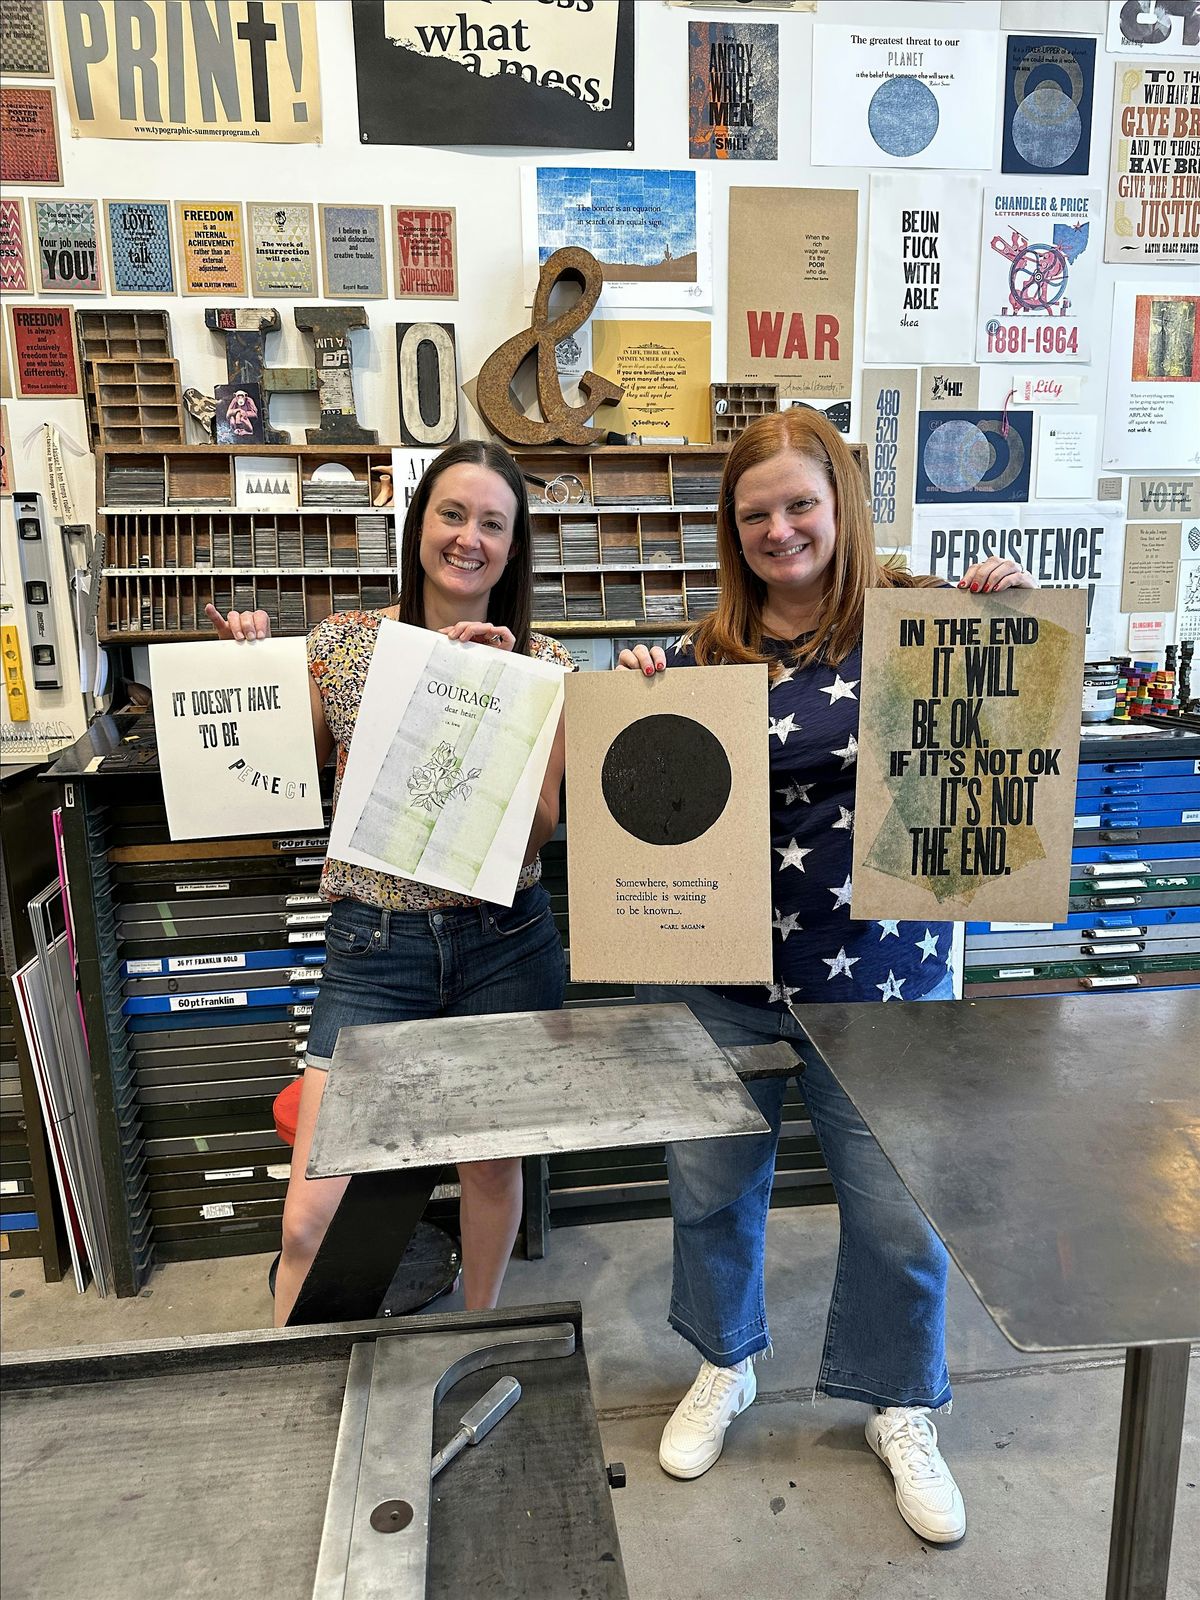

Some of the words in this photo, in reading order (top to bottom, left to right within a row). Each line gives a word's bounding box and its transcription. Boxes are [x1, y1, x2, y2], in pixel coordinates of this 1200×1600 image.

[415, 13, 531, 53] what
[851, 34, 867, 44] The
[869, 36, 903, 46] greatest
[906, 36, 931, 46] threat
[934, 38, 942, 46] to
[709, 42, 754, 73] ANGRY
[888, 51, 924, 66] PLANET
[462, 53, 481, 75] a
[499, 57, 610, 107] mess.
[710, 72, 753, 103] WHITE
[1144, 84, 1165, 104] WHO
[1166, 84, 1189, 104] HAVE
[8, 109, 38, 117] POSTER
[709, 102, 754, 127] MEN
[1121, 106, 1170, 137] GIVE
[134, 125, 261, 138] www.typographic-summerprogram.ch
[1130, 139, 1150, 156] AND
[1153, 140, 1167, 156] TO
[1129, 157, 1171, 174] HAVE
[1118, 175, 1145, 198] GIVE
[1149, 175, 1167, 198] THE
[184, 210, 234, 221] FREEDOM
[576, 204, 591, 212] The
[592, 204, 614, 212] border
[632, 205, 661, 214] equation
[995, 196, 1047, 211] CHANDLER
[1049, 197, 1058, 211] &
[1060, 198, 1089, 212] PRICE
[122, 214, 155, 230] LOVE
[397, 211, 453, 236] STOP
[626, 218, 647, 228] equals
[902, 210, 939, 233] BEUN
[39, 237, 57, 247] Your
[60, 237, 72, 249] job
[74, 238, 96, 248] needs
[194, 231, 227, 239] INTERNAL
[128, 247, 153, 264] talk
[334, 251, 354, 259] creative
[398, 237, 453, 268] VOTER
[903, 236, 939, 259] FUCK
[1144, 243, 1160, 253] LATIN
[1162, 243, 1178, 253] GRACE
[1180, 243, 1198, 253] PRAYER
[43, 250, 96, 280] YOU!
[400, 268, 454, 293] SUPPRESSION
[903, 287, 939, 310] ABLE
[16, 313, 63, 327] FREEDOM
[900, 313, 919, 327] shea
[746, 311, 840, 361] WAR
[987, 326, 1078, 353] 1881-1964
[26, 344, 60, 352] exclusively
[24, 368, 68, 378] differently.
[948, 382, 963, 396] HI!
[1034, 379, 1063, 398] Lily
[877, 389, 900, 416] 480
[876, 416, 898, 443] 520
[875, 443, 897, 470] 602
[874, 470, 896, 497] 623
[1140, 482, 1193, 512] VOTE
[873, 498, 895, 523] 928
[930, 528, 1104, 583] PERSISTENCE
[900, 619, 925, 646] IN
[934, 618, 982, 646] THE
[989, 617, 1038, 645] END
[932, 648, 954, 698] IT
[964, 647, 1019, 697] WILL
[172, 692, 186, 717] IT
[191, 687, 242, 715] DOESN'T
[248, 685, 281, 711] HAVE
[427, 680, 502, 714] COURAGE,
[444, 705, 458, 714] dear
[460, 708, 477, 719] heart
[912, 698, 941, 749] BE
[949, 698, 989, 749] OK.
[199, 724, 218, 748] TO
[221, 722, 239, 747] BE
[889, 750, 911, 777] IF
[919, 750, 965, 776] IT'S
[974, 749, 1022, 776] NOT
[1028, 749, 1061, 776] OK
[228, 758, 306, 799] PERFECT
[940, 777, 982, 826] IT'S
[991, 777, 1038, 826] NOT
[281, 840, 294, 848] 60
[909, 827, 952, 876] THE
[961, 826, 1011, 876] END.
[616, 878, 669, 888] Somewhere,
[672, 878, 719, 890] something
[616, 892, 658, 901] incredible
[662, 892, 669, 901] is
[673, 892, 706, 904] waiting
[629, 906, 639, 915] be
[194, 957, 221, 966] FRANKLIN
[223, 955, 238, 963] BOLD
